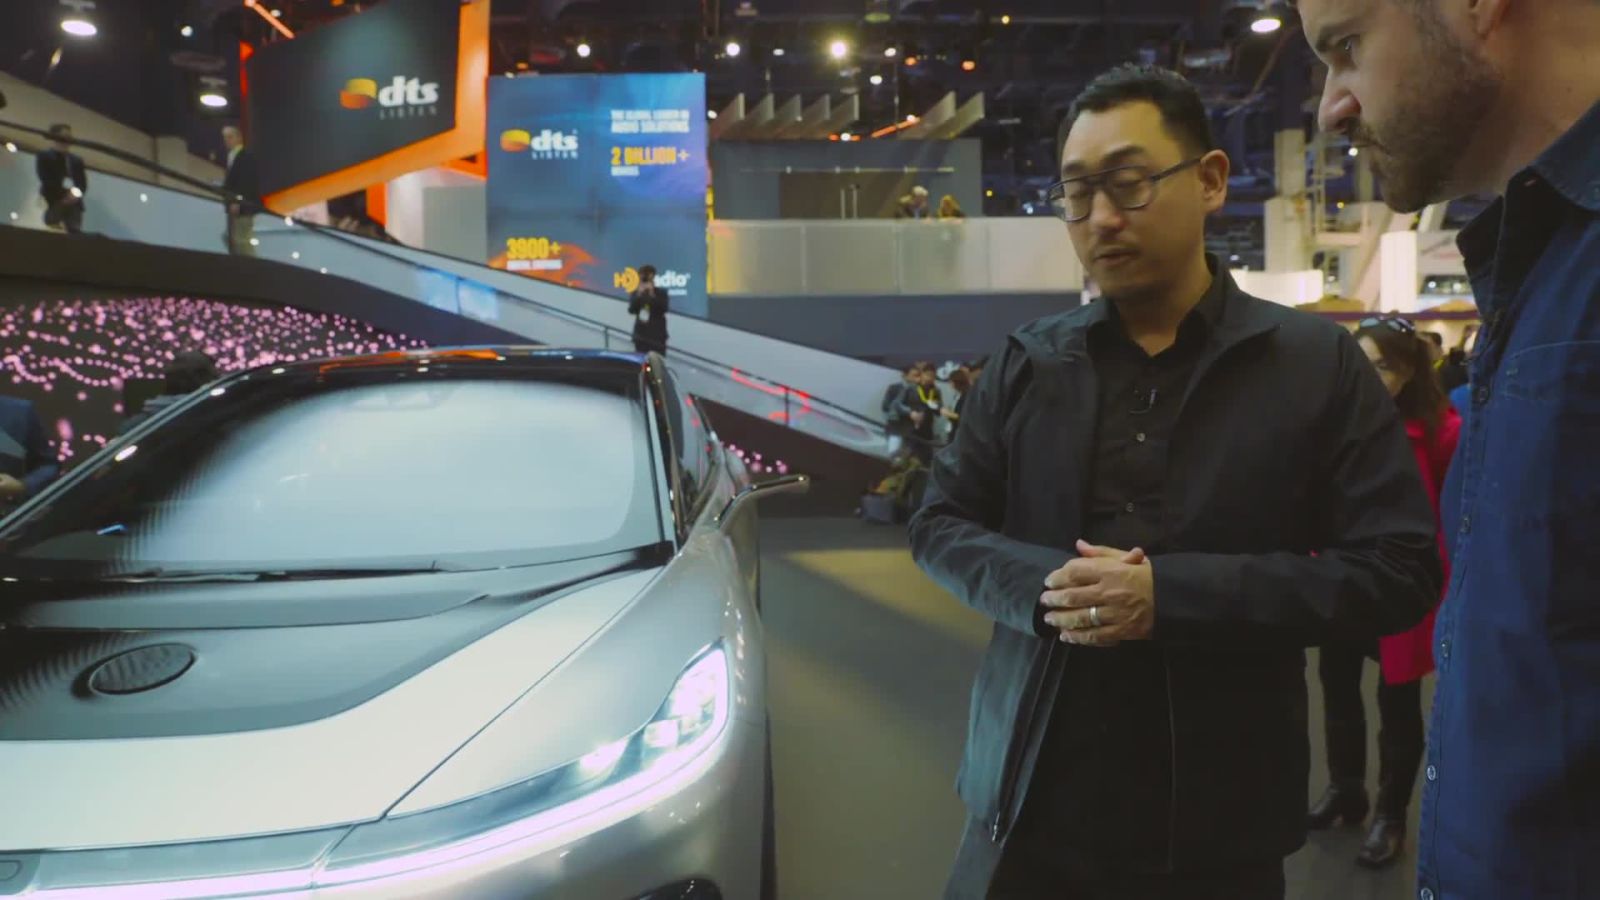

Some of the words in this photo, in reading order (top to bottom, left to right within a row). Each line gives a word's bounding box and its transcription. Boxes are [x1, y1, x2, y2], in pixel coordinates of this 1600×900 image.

[379, 75, 439, 107] dts
[531, 129, 579, 151] dts
[611, 146, 621, 165] 2
